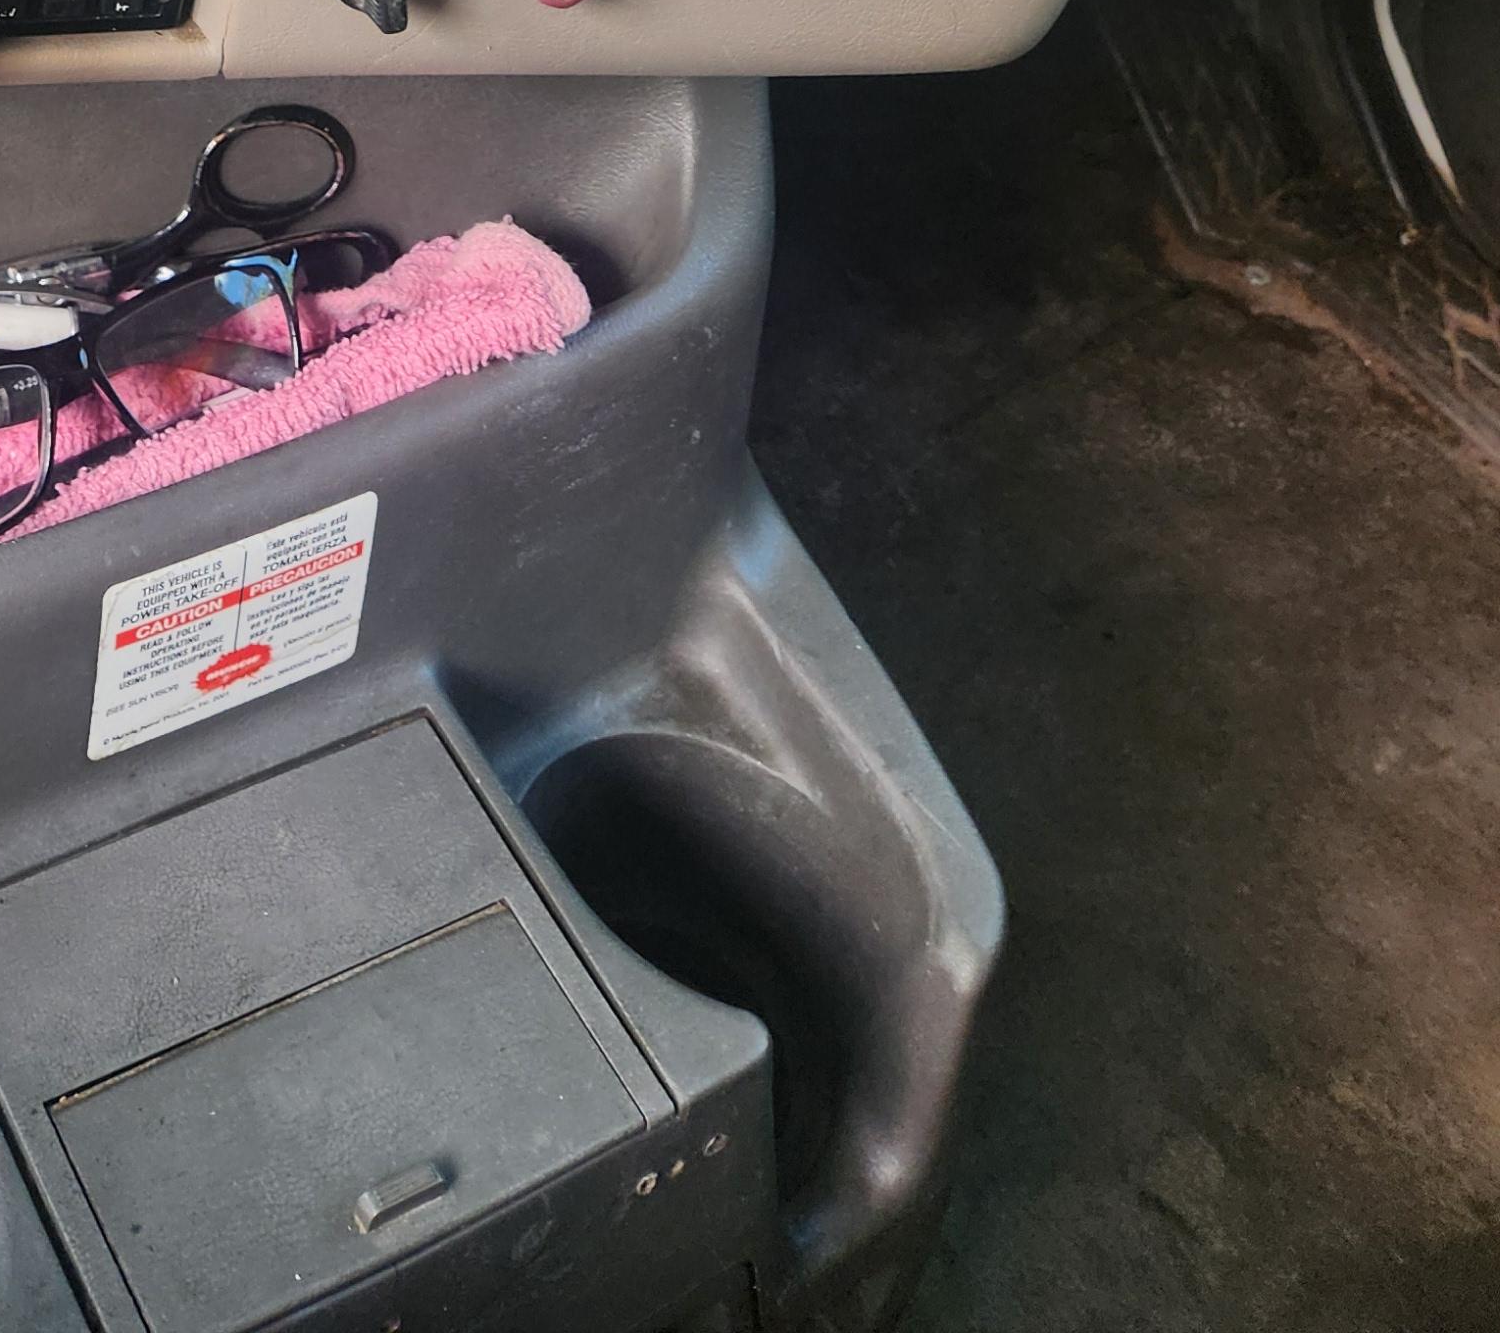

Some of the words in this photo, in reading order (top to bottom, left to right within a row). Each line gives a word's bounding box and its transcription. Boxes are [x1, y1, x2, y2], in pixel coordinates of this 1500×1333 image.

[248, 545, 359, 598] PRECAUCION
[262, 535, 348, 574] TOMAFUERZA
[136, 584, 187, 611] EQUIPPED
[189, 576, 216, 591] WITH
[142, 581, 165, 598] THIS
[168, 565, 210, 588] VEHICLE
[212, 560, 223, 572] IS
[120, 602, 171, 627] POWER
[175, 576, 240, 608] TAKE-OFF
[134, 598, 224, 640] CAUTION
[140, 637, 164, 652] READ
[175, 619, 214, 639] FOLLOW
[150, 633, 201, 659] OPERATING
[122, 648, 189, 679] INSTRUCTIONS
[190, 634, 225, 653] BEFORE
[118, 672, 148, 690] USING
[149, 665, 170, 679] THIS
